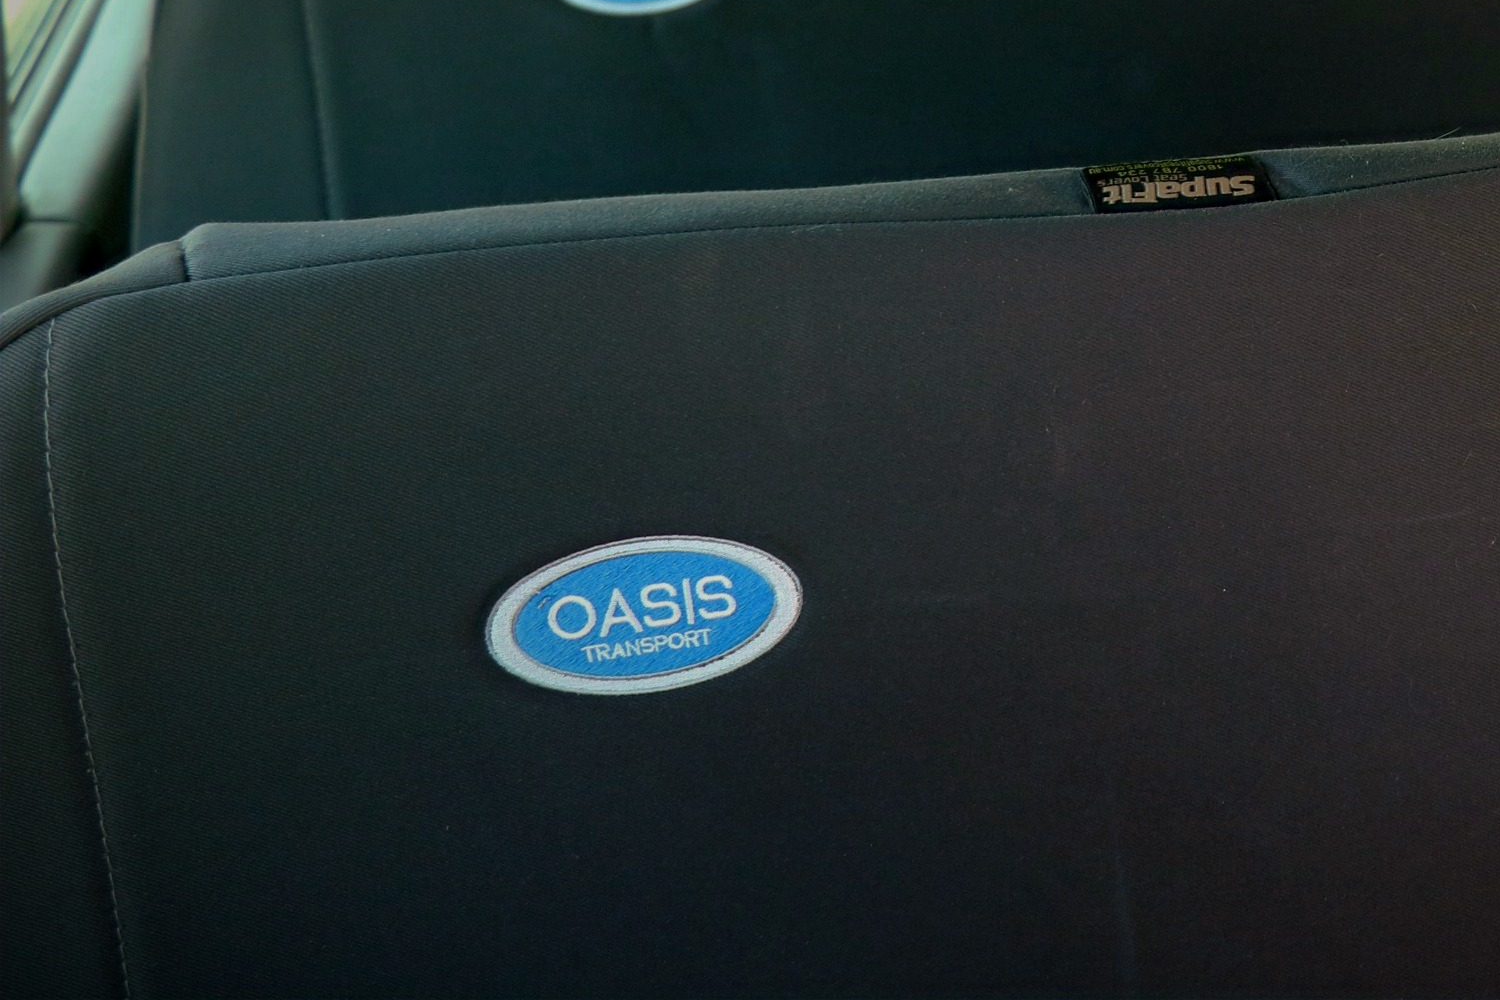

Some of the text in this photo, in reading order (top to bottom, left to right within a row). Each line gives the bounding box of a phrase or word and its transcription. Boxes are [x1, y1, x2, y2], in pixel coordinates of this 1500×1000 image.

[1102, 175, 1255, 205] SupaFit
[547, 574, 738, 640] OASIS
[580, 628, 711, 663] TRANSPORT
